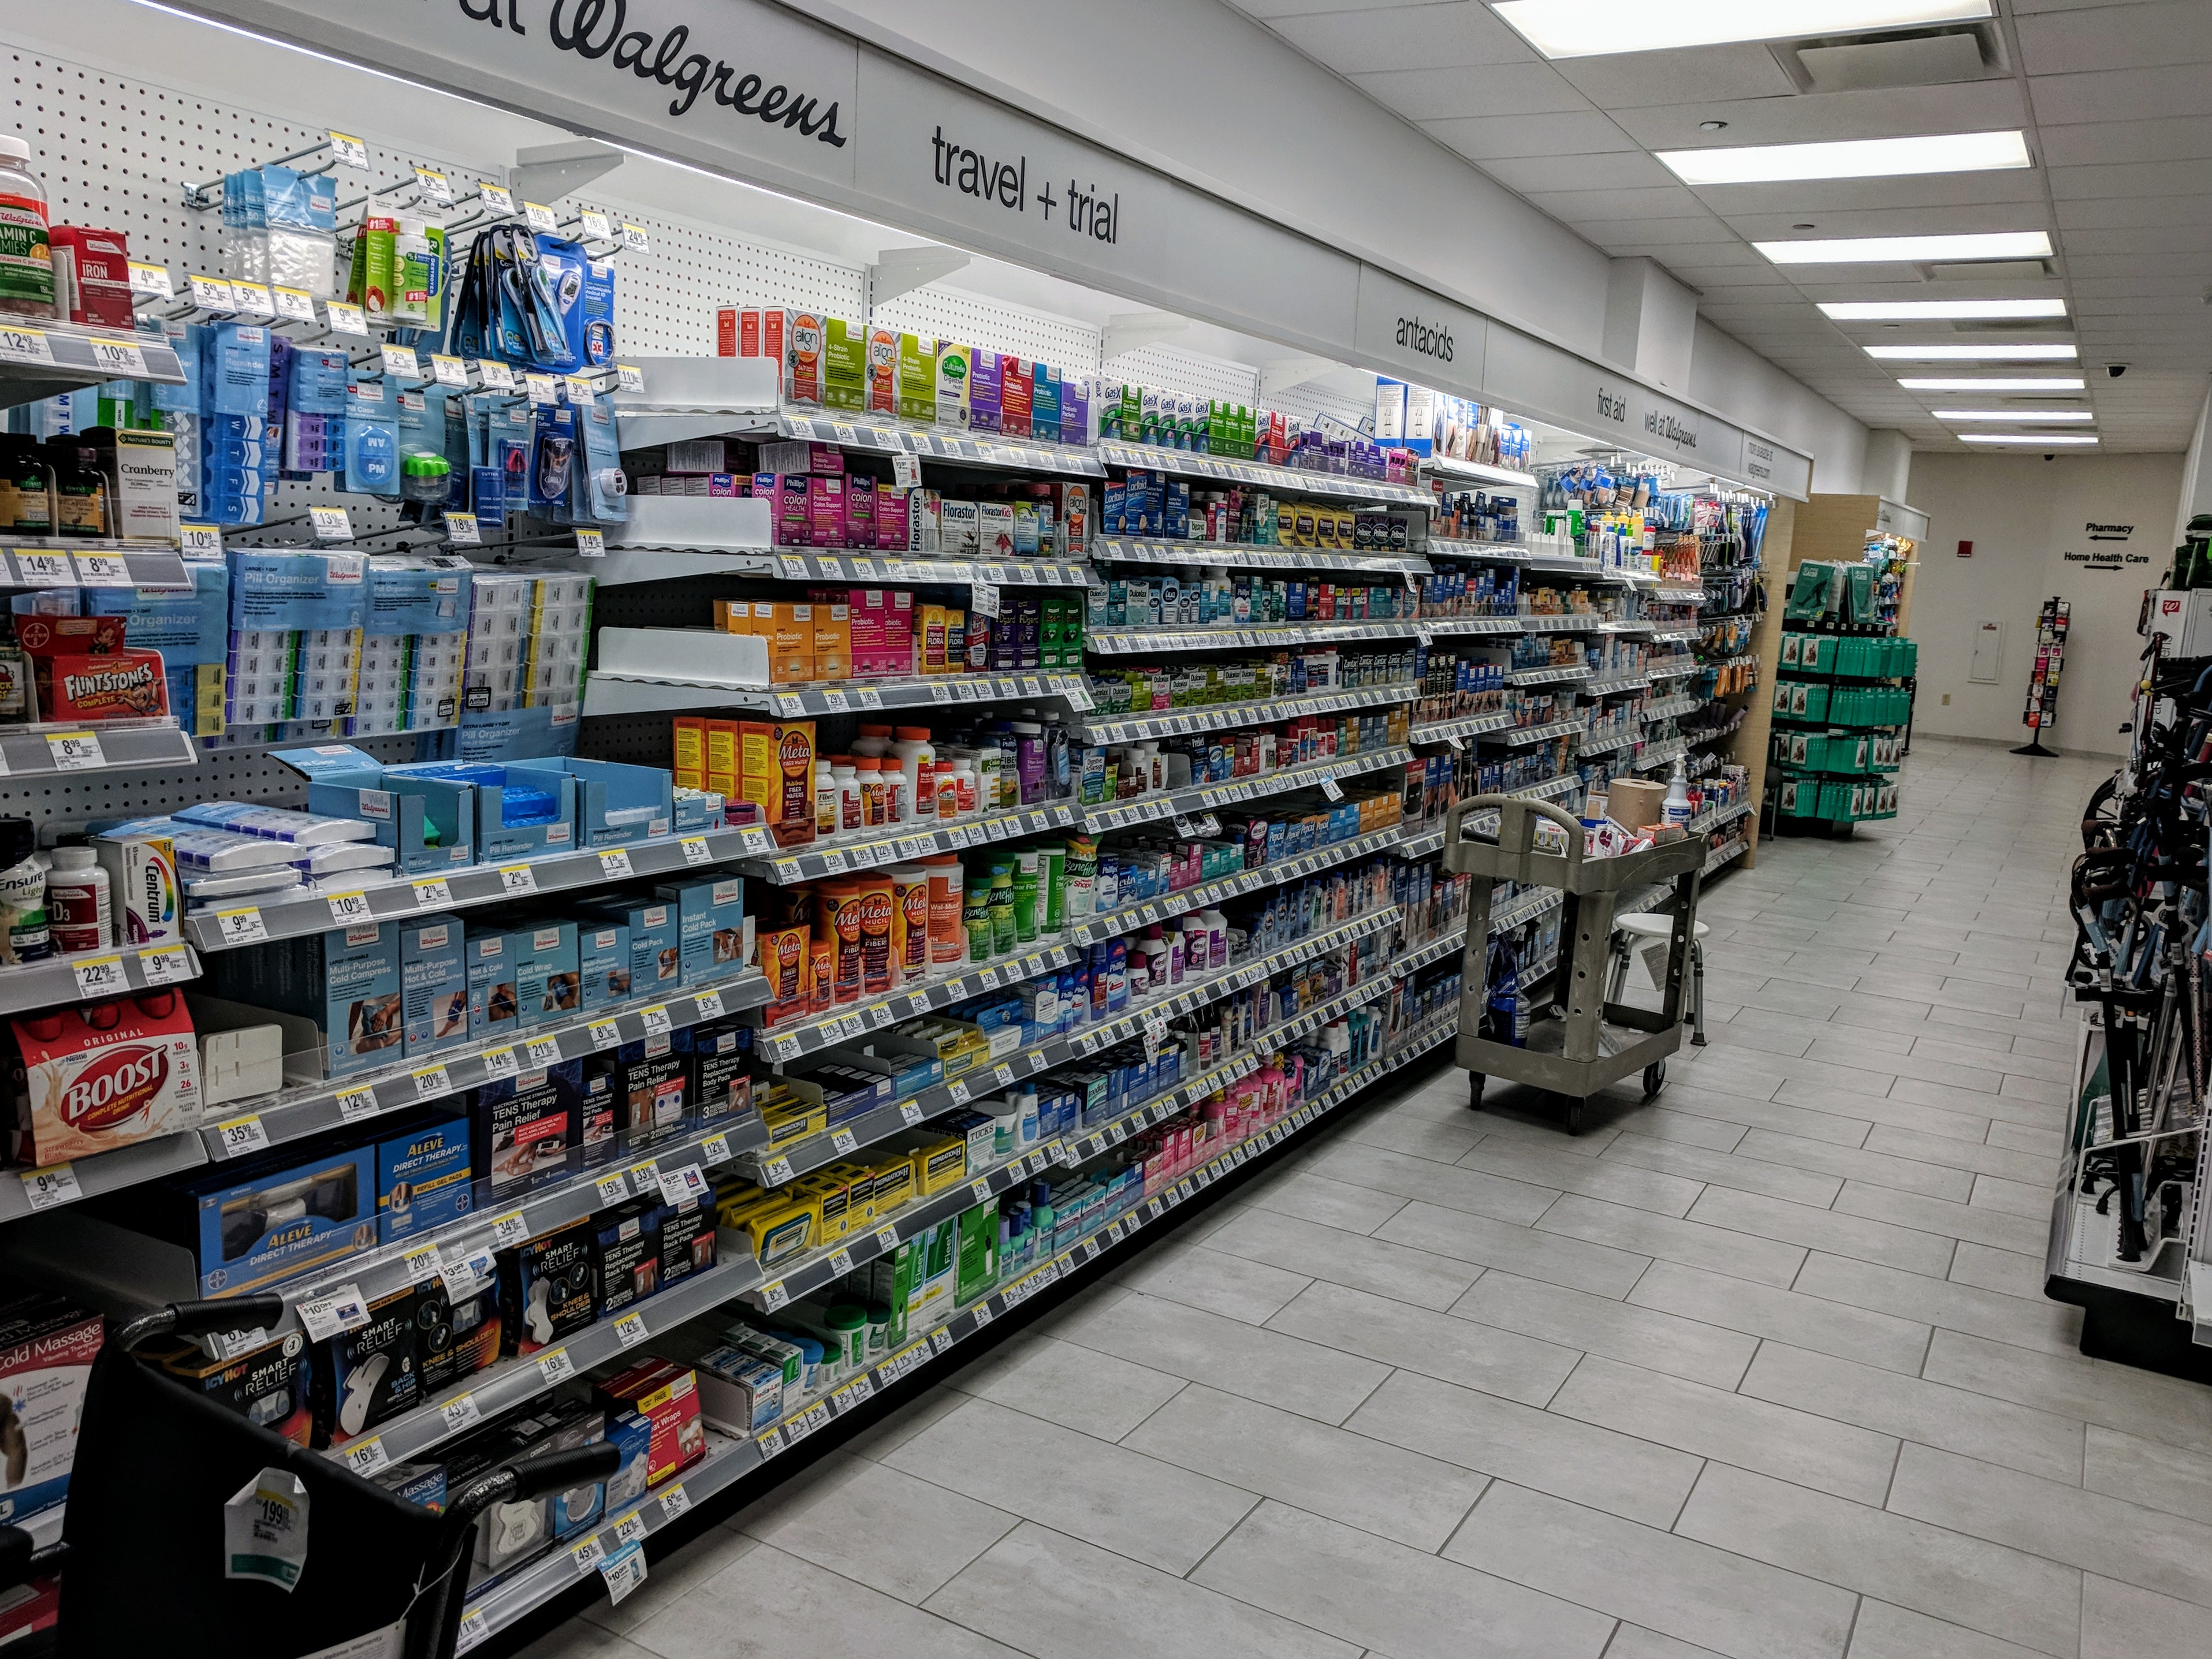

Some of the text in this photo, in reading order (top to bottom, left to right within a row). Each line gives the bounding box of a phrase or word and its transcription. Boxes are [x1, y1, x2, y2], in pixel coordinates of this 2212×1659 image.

[549, 0, 847, 148] Walgreens
[932, 125, 1118, 244] travel + trial
[81, 263, 109, 279] IRON
[795, 327, 818, 351] align
[1397, 316, 1453, 362] antacids
[873, 344, 892, 365] align
[943, 360, 966, 374] Culturelle
[944, 375, 963, 385] Digestive
[1597, 387, 1626, 423] first aid
[1645, 410, 1696, 450] well at Walgreens
[121, 463, 174, 479] Cranberry
[368, 464, 385, 474] PM
[712, 487, 732, 497] colon
[755, 487, 774, 497] colon
[1127, 479, 1148, 492] Lactaid
[784, 494, 807, 506] colon
[1070, 495, 1086, 513] align
[1105, 491, 1125, 504] Lactaid
[943, 505, 976, 520] Florastor
[911, 495, 921, 552] Florastor
[2086, 523, 2134, 534] Pharmacy
[2064, 552, 2149, 564] Home Health Care
[244, 573, 319, 586] Pill Organizer
[129, 614, 197, 627] Organizer
[851, 618, 875, 626] Probiotic
[777, 632, 803, 641] Probiotic
[815, 632, 841, 641] Probiotic
[64, 662, 154, 702] FLINTSTONES
[77, 696, 116, 709] COMPLETE
[462, 726, 521, 740] Pill Organizer
[779, 745, 811, 760] Meta
[605, 830, 632, 841] Reminder
[502, 842, 534, 853] Reminder
[146, 865, 161, 924] Centrum
[683, 911, 706, 923] Instant
[859, 906, 892, 919] Meta
[683, 918, 717, 933] Cold Pack
[632, 938, 664, 950] Cold Pack
[778, 943, 802, 956] Meta
[329, 958, 386, 975] Multi-Purpose
[405, 958, 457, 975] Multi-Purpose
[517, 963, 552, 976] Cold Wrap
[330, 966, 392, 985] Cold Compress
[405, 975, 419, 984] Hot
[428, 968, 446, 979] Cold
[84, 1028, 144, 1047] ORIGINAL
[628, 1060, 680, 1081] TENS Therapy
[703, 1056, 740, 1071] TENS Therapy
[703, 1065, 737, 1080] Replacement
[703, 1073, 731, 1087] Body Pads
[68, 1043, 168, 1120] BOOST
[181, 1080, 191, 1088] 26
[628, 1081, 645, 1093] Pain
[647, 1073, 667, 1086] Relief
[88, 1084, 153, 1121] COMPLETE NUTRITIONAL
[113, 1102, 131, 1116] DRINK
[493, 1094, 557, 1120] TENS Therapy
[493, 1121, 512, 1133] Pain
[515, 1110, 541, 1126] Relief
[970, 1124, 994, 1142] TUCKS
[407, 1137, 444, 1158] ALEVE
[393, 1143, 462, 1173] DIRECT THERAPY
[449, 1173, 463, 1182] PADS
[267, 1224, 312, 1250] ALEVE
[664, 1222, 701, 1242] Replacement
[249, 1230, 333, 1266] DIRECT THERAPY
[664, 1233, 693, 1250] Back Pads
[944, 1232, 952, 1265] Fleet
[541, 1247, 580, 1272] RELIEF
[545, 1242, 574, 1260] SMART
[605, 1240, 645, 1262] TENS Therapy
[605, 1249, 642, 1270] Replacement
[605, 1261, 635, 1278] Back Pads
[915, 1254, 924, 1283] Fleet
[550, 1299, 590, 1321] SHOULDER
[563, 1295, 583, 1308] KNEE
[362, 1317, 396, 1340] SMART
[35, 1324, 100, 1357] Massage
[357, 1322, 404, 1354] RELIEF
[422, 1353, 446, 1369] KNEE
[456, 1328, 494, 1353] SHOULDER
[252, 1357, 289, 1381] SMART
[245, 1362, 298, 1396] RELIEF
[391, 1371, 415, 1389] BACK
[661, 1410, 682, 1426] Wraps
